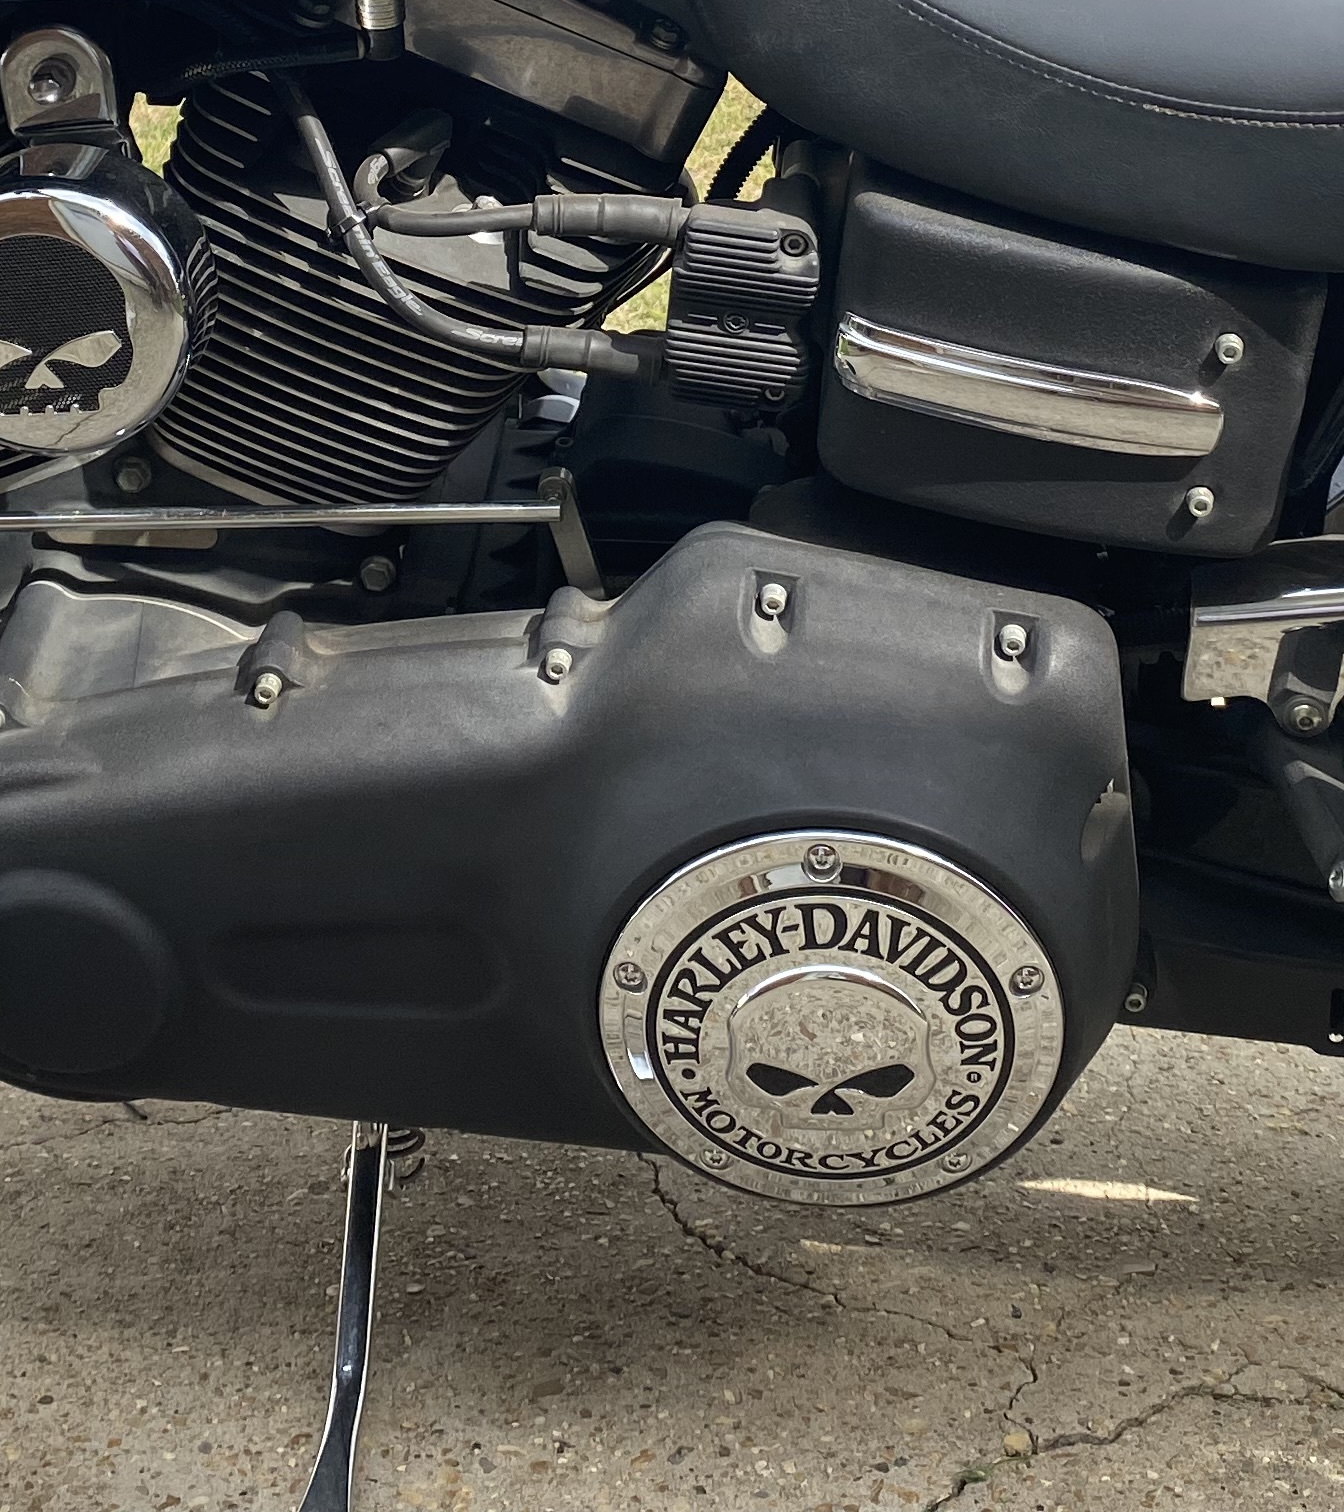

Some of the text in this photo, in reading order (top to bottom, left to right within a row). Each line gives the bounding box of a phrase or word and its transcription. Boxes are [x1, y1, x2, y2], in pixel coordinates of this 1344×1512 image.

[372, 259, 421, 316] Eagle
[662, 902, 998, 1071] HARLEY-DAVIDSON
[680, 1085, 980, 1171] MOTORCYCLES
